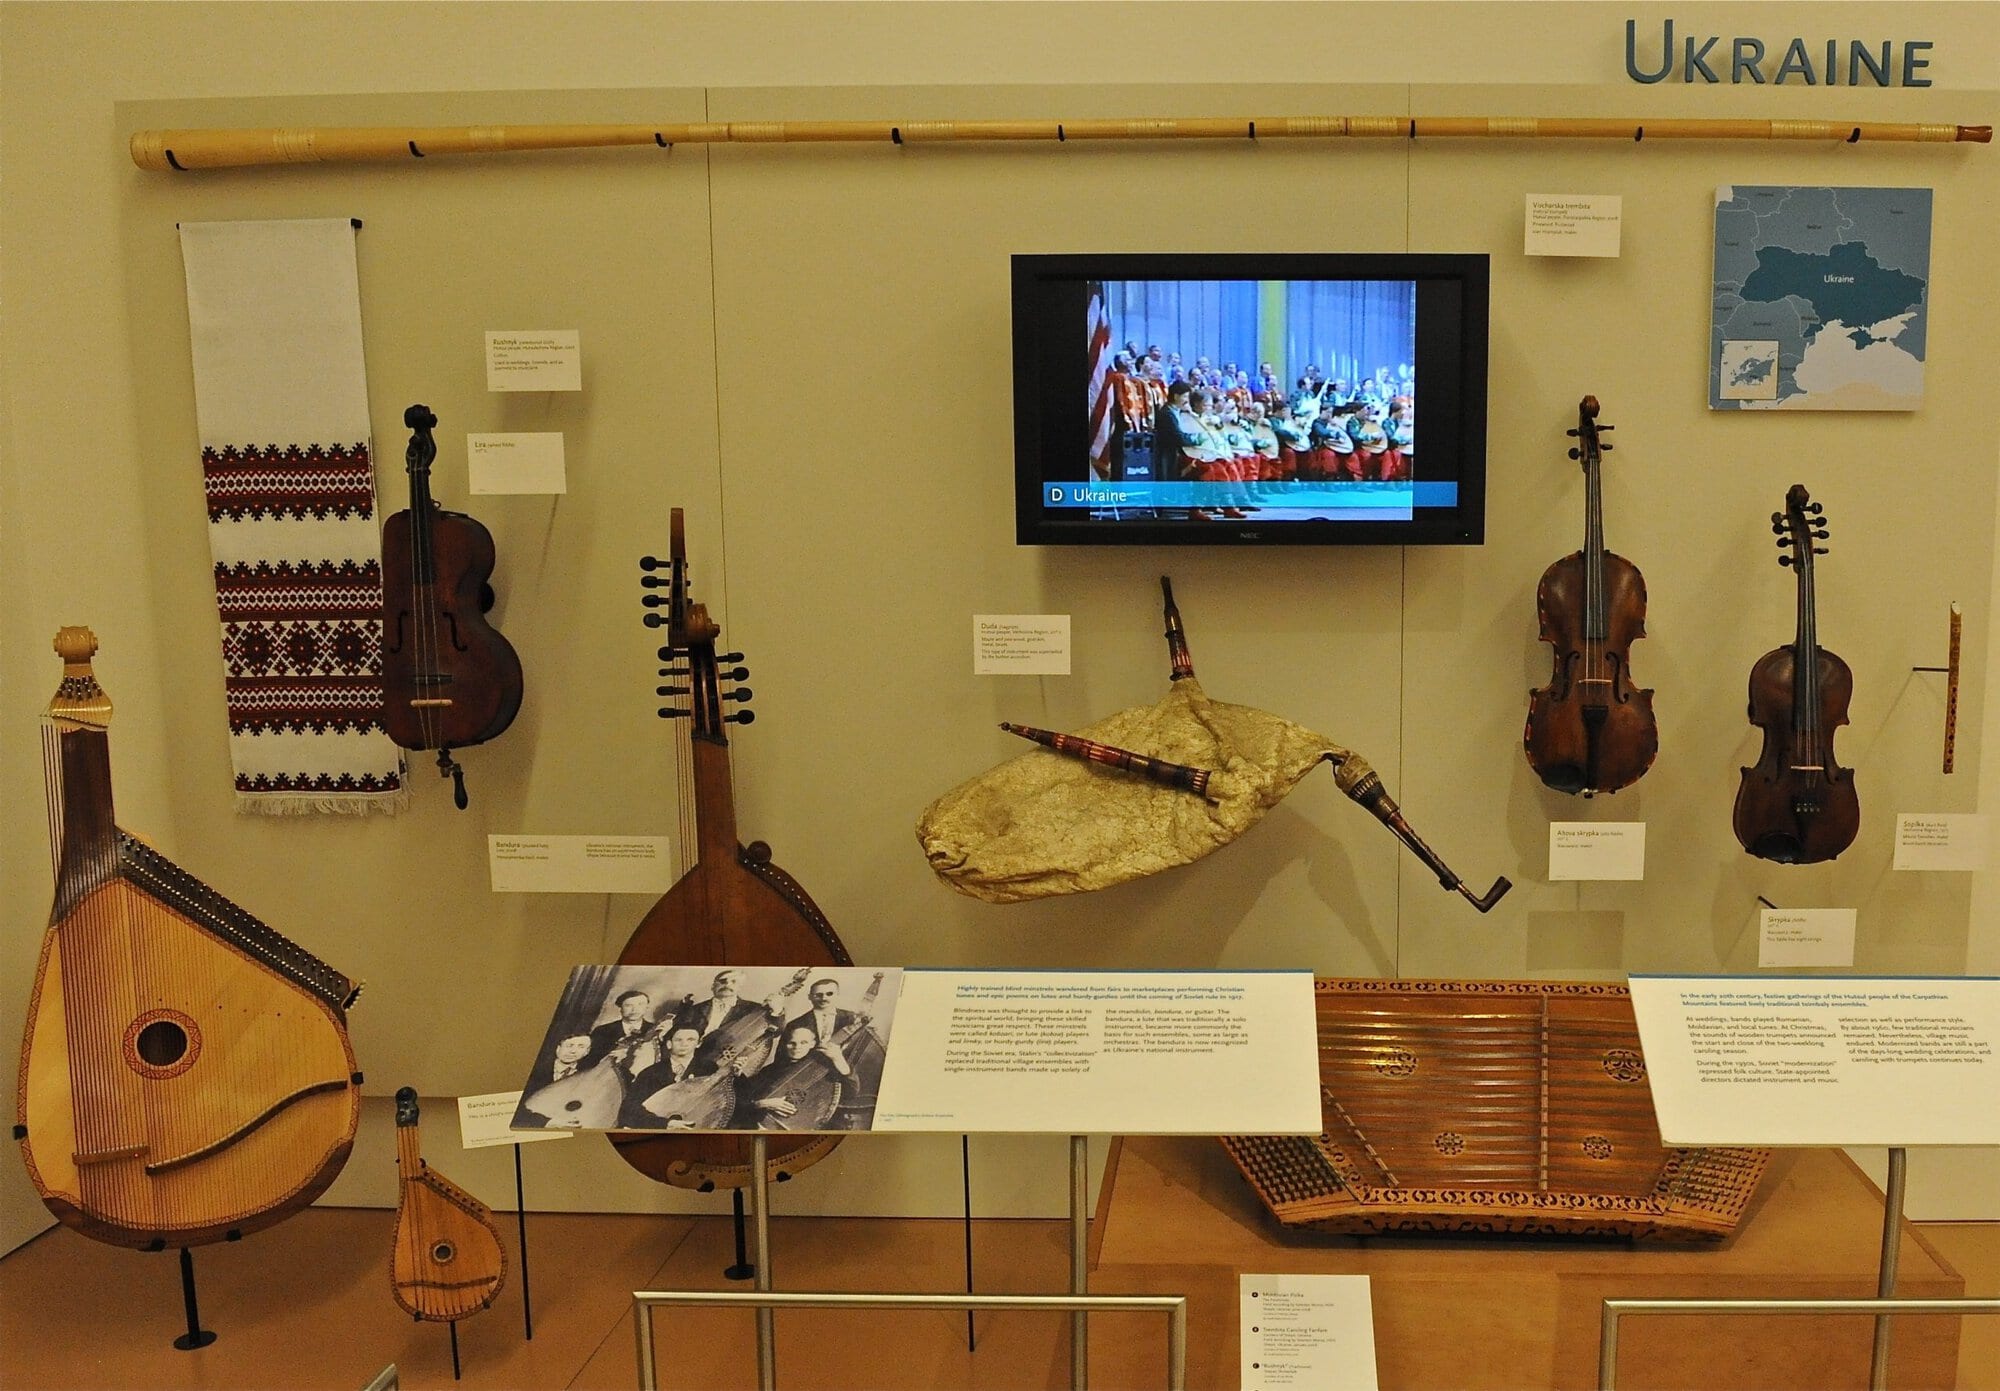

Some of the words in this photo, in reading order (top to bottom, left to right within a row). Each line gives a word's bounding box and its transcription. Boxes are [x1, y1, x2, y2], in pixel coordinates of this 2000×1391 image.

[1625, 19, 1934, 87] UKRAINE
[1823, 274, 1854, 284] Ukraine
[1052, 488, 1063, 501] D
[1074, 487, 1127, 501] Ukraine
[1768, 916, 1791, 925] Skrypka
[957, 985, 979, 993] Highly
[1753, 1016, 1774, 1024] played
[946, 1050, 969, 1058] During
[1694, 1048, 1721, 1056] caroling
[1696, 1060, 1720, 1068] During
